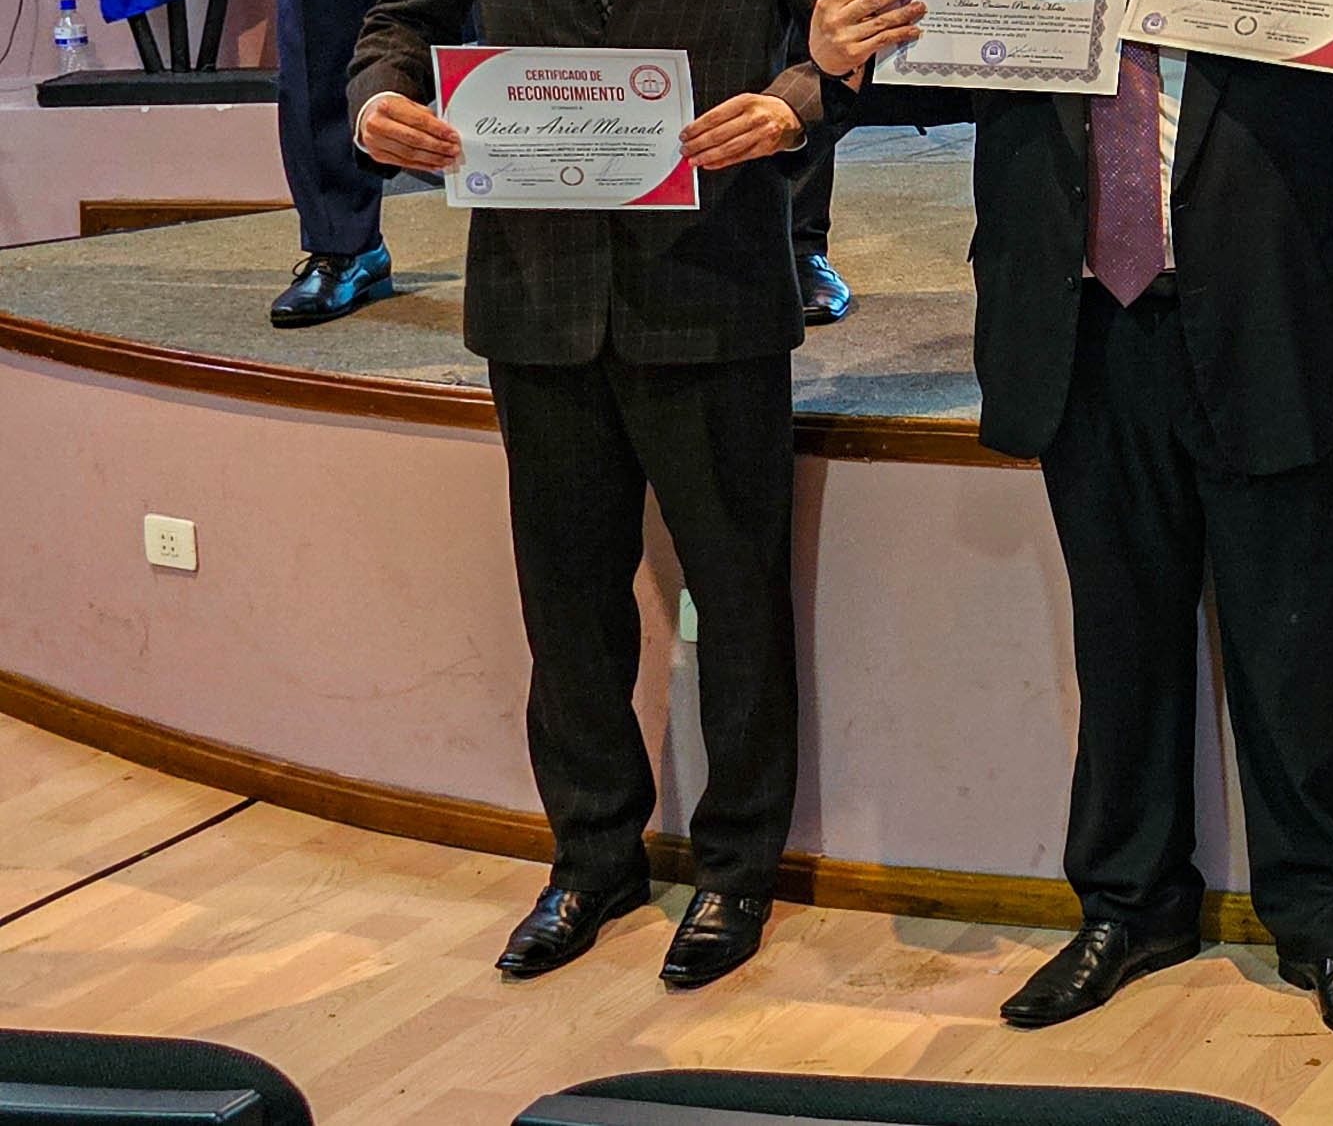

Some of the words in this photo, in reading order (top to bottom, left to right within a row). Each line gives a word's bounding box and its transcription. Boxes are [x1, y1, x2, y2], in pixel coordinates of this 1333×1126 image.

[525, 70, 588, 82] CERTIFICADO
[591, 70, 602, 82] DE
[507, 86, 625, 102] RECONOCIMIENTO
[536, 116, 586, 135] Ariel
[591, 117, 664, 136] Mercado
